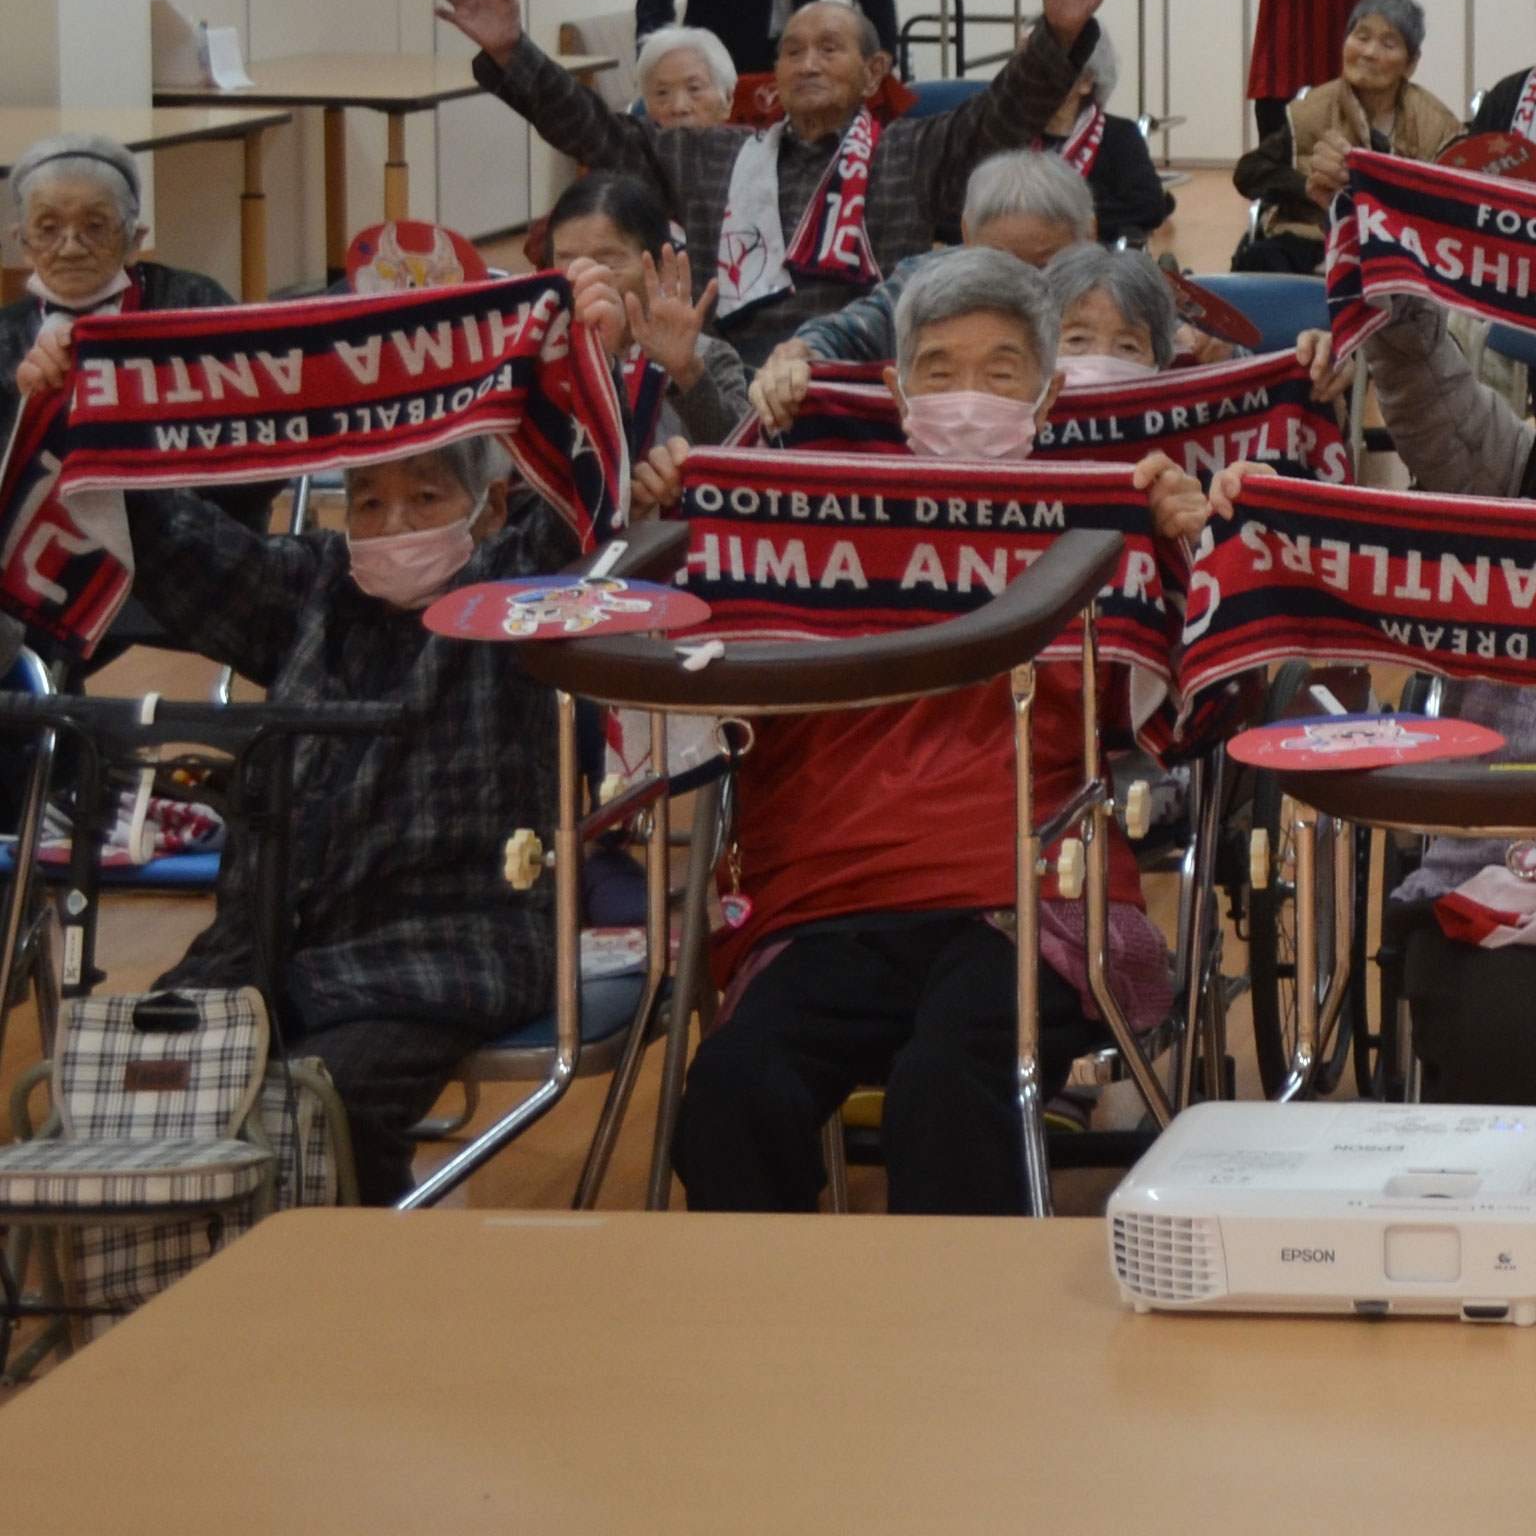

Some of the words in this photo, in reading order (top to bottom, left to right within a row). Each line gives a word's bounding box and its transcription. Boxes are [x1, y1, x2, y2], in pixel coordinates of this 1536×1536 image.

[333, 301, 535, 387] HIMA
[82, 346, 304, 407] ANTLE
[155, 415, 309, 453] DREAM
[1039, 416, 1124, 446] BALL
[1144, 386, 1270, 436] DREAM
[1183, 417, 1348, 484] NTLERS
[682, 483, 891, 522] OOTBALL
[915, 496, 1067, 528] DREAM
[675, 532, 869, 590] HIMA
[1380, 618, 1529, 661] DREAM
[1280, 1247, 1336, 1263] EPSON
